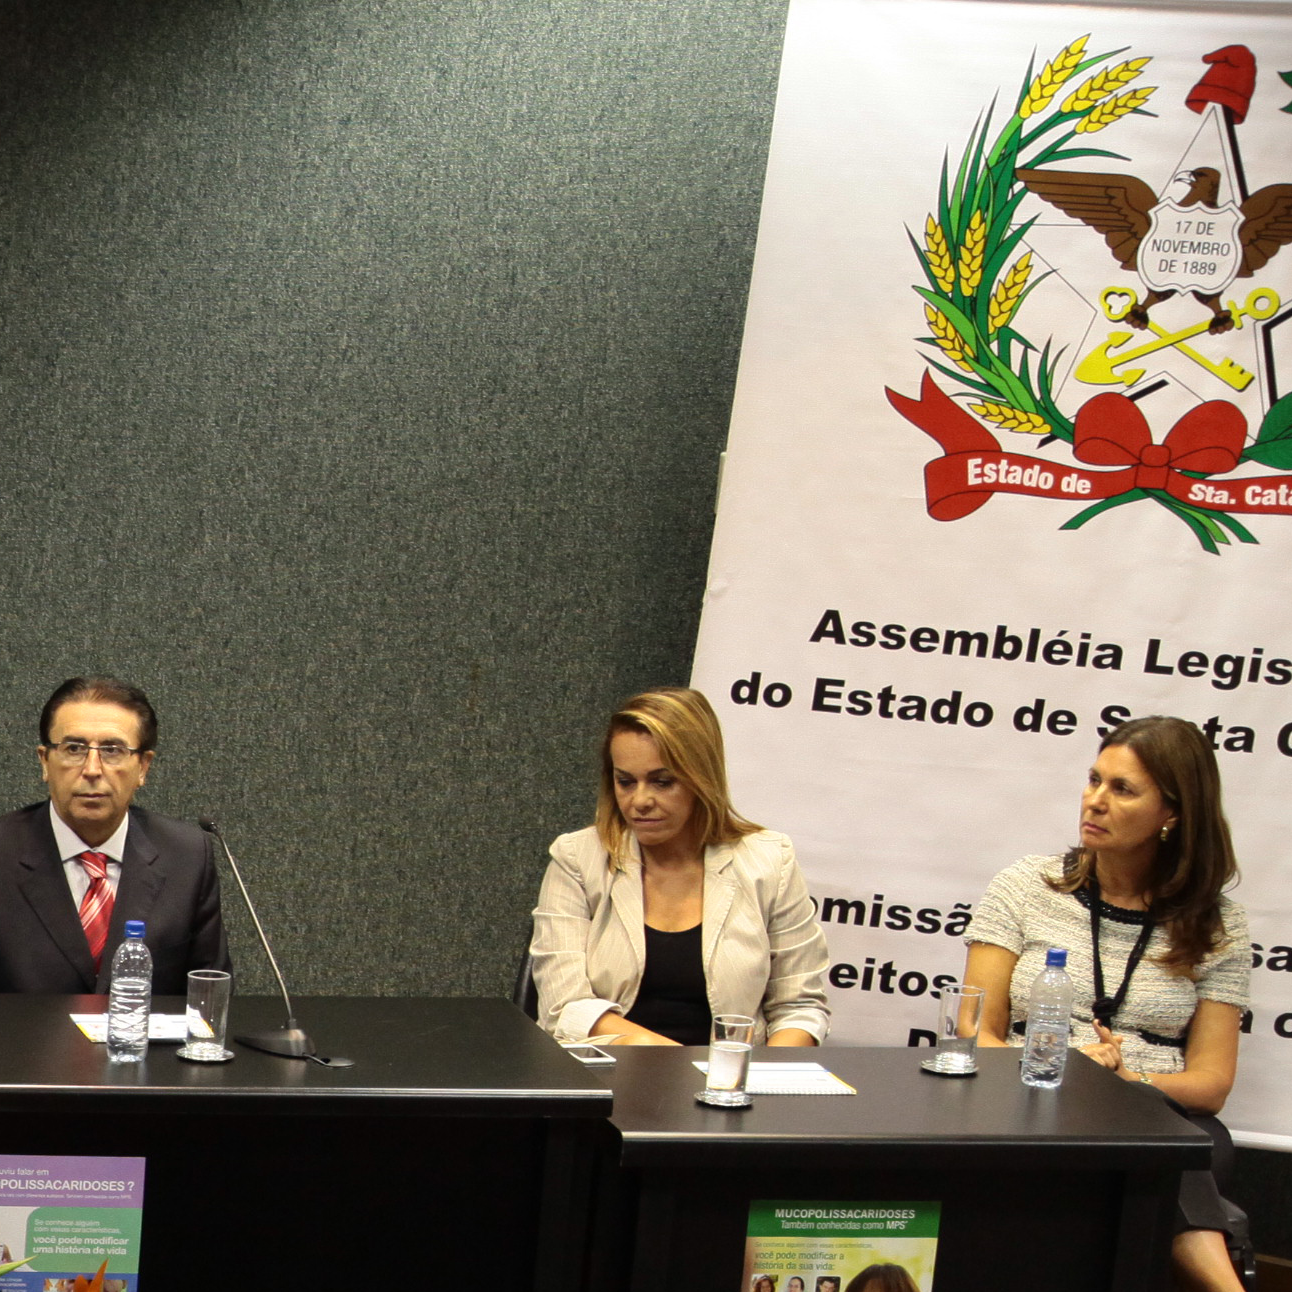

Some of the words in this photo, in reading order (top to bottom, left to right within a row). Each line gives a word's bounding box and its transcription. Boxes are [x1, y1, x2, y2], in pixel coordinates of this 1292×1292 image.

[1176, 220, 1192, 234] 17
[1195, 221, 1215, 235] DE
[1151, 239, 1231, 257] NOVEMBRO
[1158, 259, 1178, 273] DE
[1182, 260, 1216, 275] 1889
[967, 457, 1055, 490] Estado
[1061, 474, 1092, 495] de
[1188, 483, 1236, 505] Sta.
[808, 608, 1124, 672] Assembléia
[1143, 637, 1292, 691] Legis
[730, 671, 793, 709] do
[810, 677, 994, 728] Estado
[1012, 698, 1078, 736] de
[1097, 704, 1256, 754] Sta
[17, 1167, 35, 1176] falar
[127, 1181, 135, 1192] ?
[774, 1208, 915, 1219] MUCOPOLISSACARIDOSES
[780, 1219, 814, 1230] Também
[816, 1220, 861, 1230] conhecidas
[862, 1222, 884, 1230] como
[33, 1235, 57, 1244] você
[58, 1236, 82, 1245] pode
[84, 1236, 129, 1245] modificar
[55, 1246, 91, 1254] história
[92, 1246, 105, 1254] de
[106, 1247, 127, 1255] vida
[754, 1250, 773, 1259] você
[775, 1251, 796, 1261] pode
[798, 1251, 836, 1260] modificar
[786, 1261, 796, 1270] da
